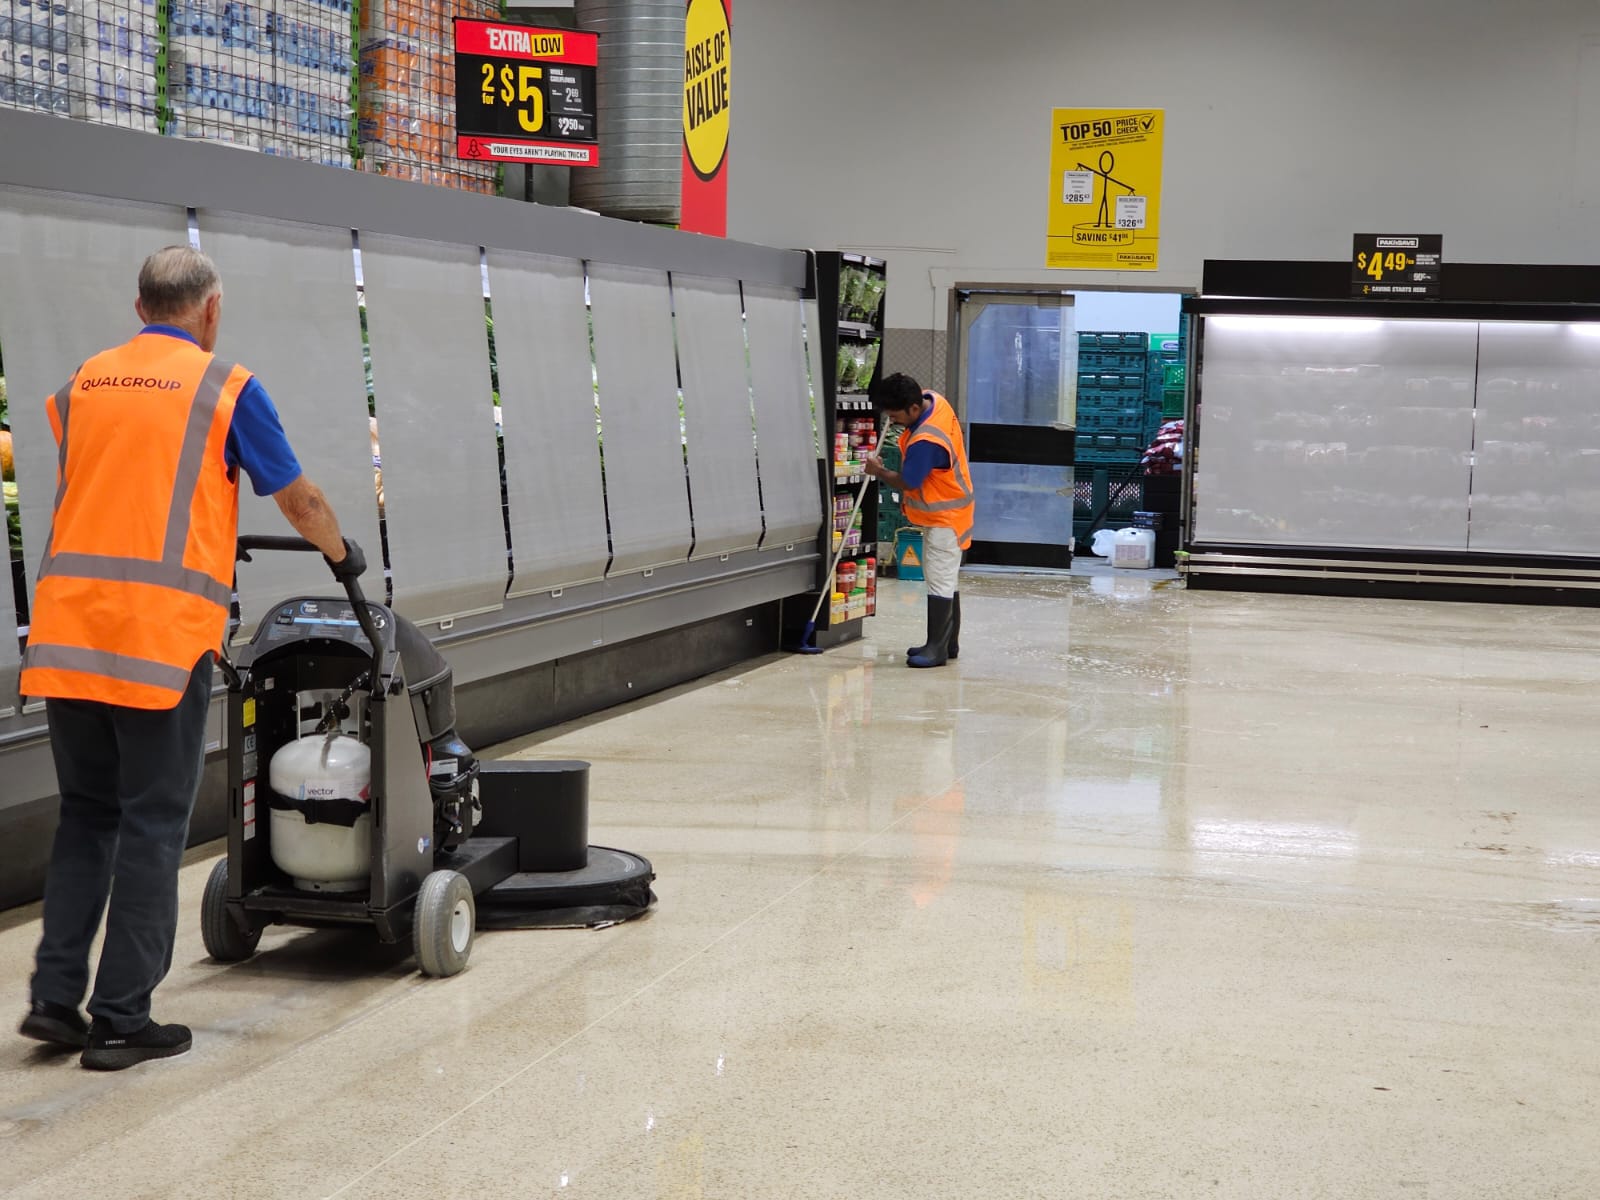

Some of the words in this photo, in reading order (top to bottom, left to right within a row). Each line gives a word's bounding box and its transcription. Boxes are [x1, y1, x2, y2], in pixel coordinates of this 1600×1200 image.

[488, 29, 531, 53] EXTRA
[534, 37, 561, 54] LOW
[686, 38, 712, 83] AISLE
[714, 29, 726, 65] OF
[481, 63, 495, 92] 2
[500, 64, 544, 132] $5
[482, 92, 494, 105] for
[686, 66, 729, 131] VALUE
[1116, 117, 1138, 127] PRICE
[1060, 123, 1090, 141] TOP
[1093, 120, 1112, 138] 50
[1116, 126, 1139, 135] CHECK
[493, 146, 509, 154] YOUR
[509, 148, 523, 156] EYES
[544, 150, 567, 159] PLAYING
[568, 151, 587, 160] TRICKS
[1076, 232, 1107, 242] SAVING
[81, 377, 182, 391] QUALGROUP
[307, 787, 334, 796] vector
